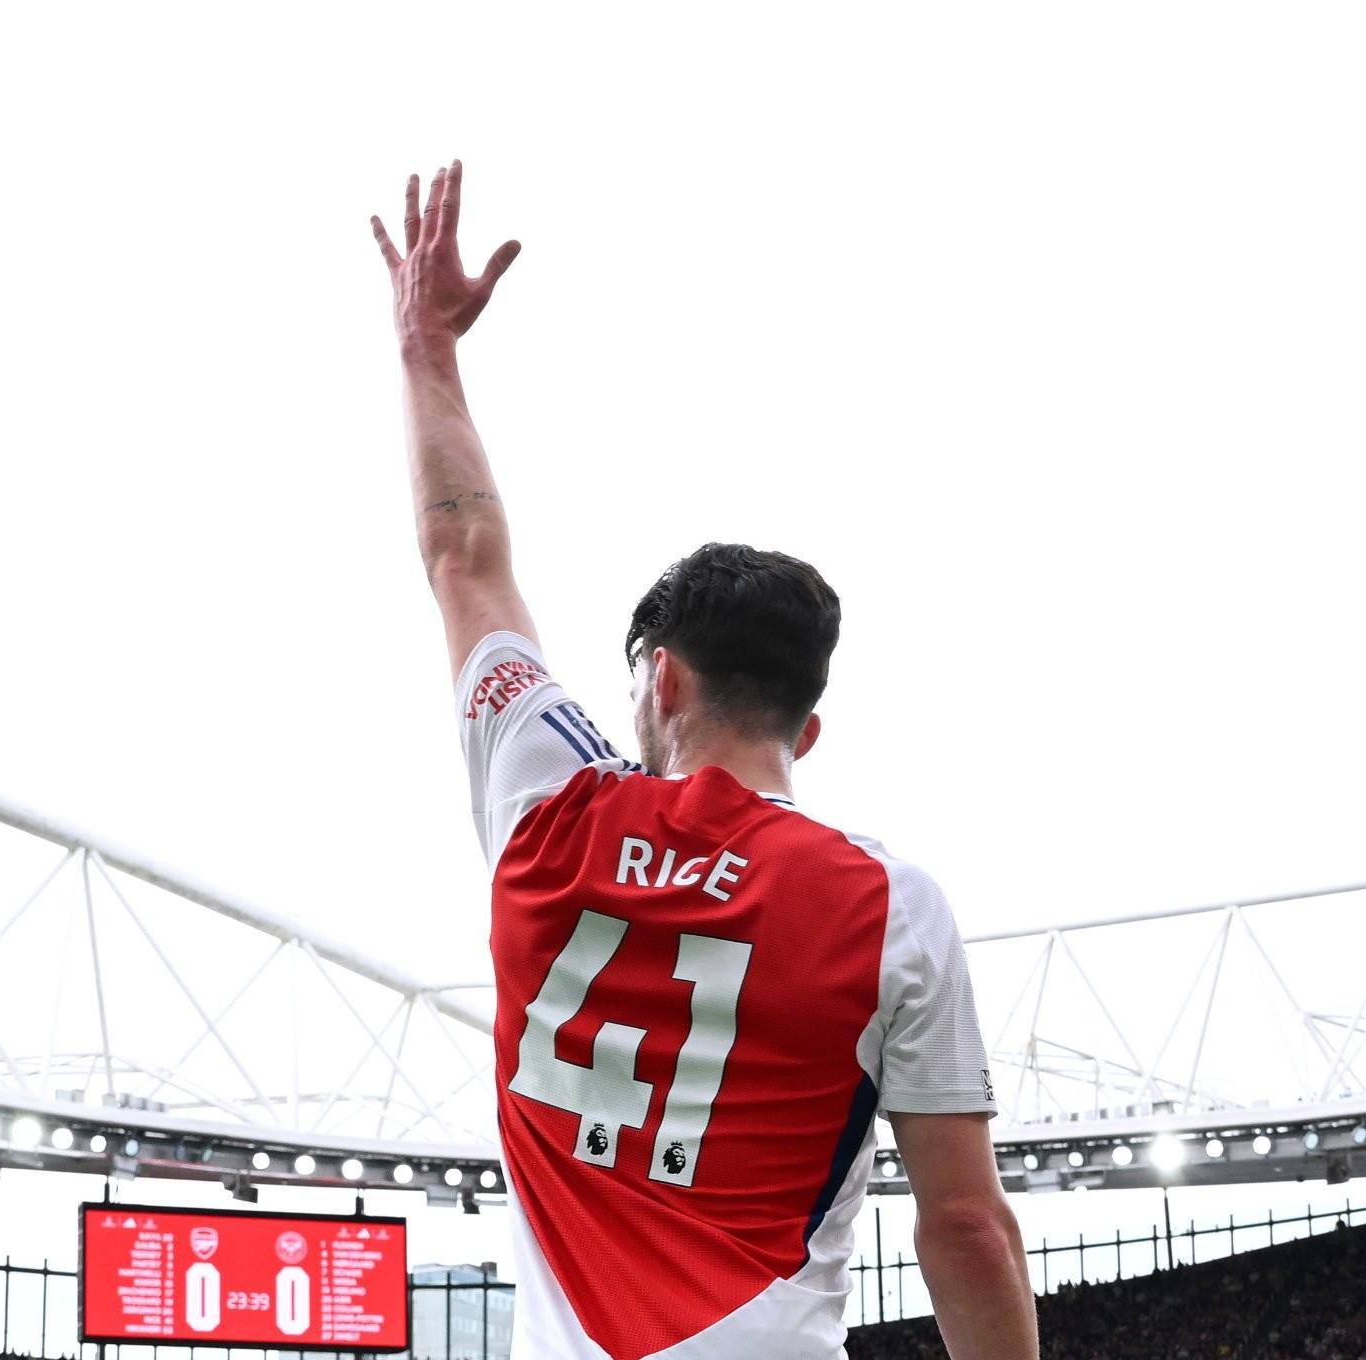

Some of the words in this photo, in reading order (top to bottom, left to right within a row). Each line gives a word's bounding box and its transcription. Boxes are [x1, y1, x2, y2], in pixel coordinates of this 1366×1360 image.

[615, 836, 749, 902] RICE
[508, 908, 753, 1188] 41
[186, 1262, 221, 1332] 0
[275, 1266, 310, 1335] 0
